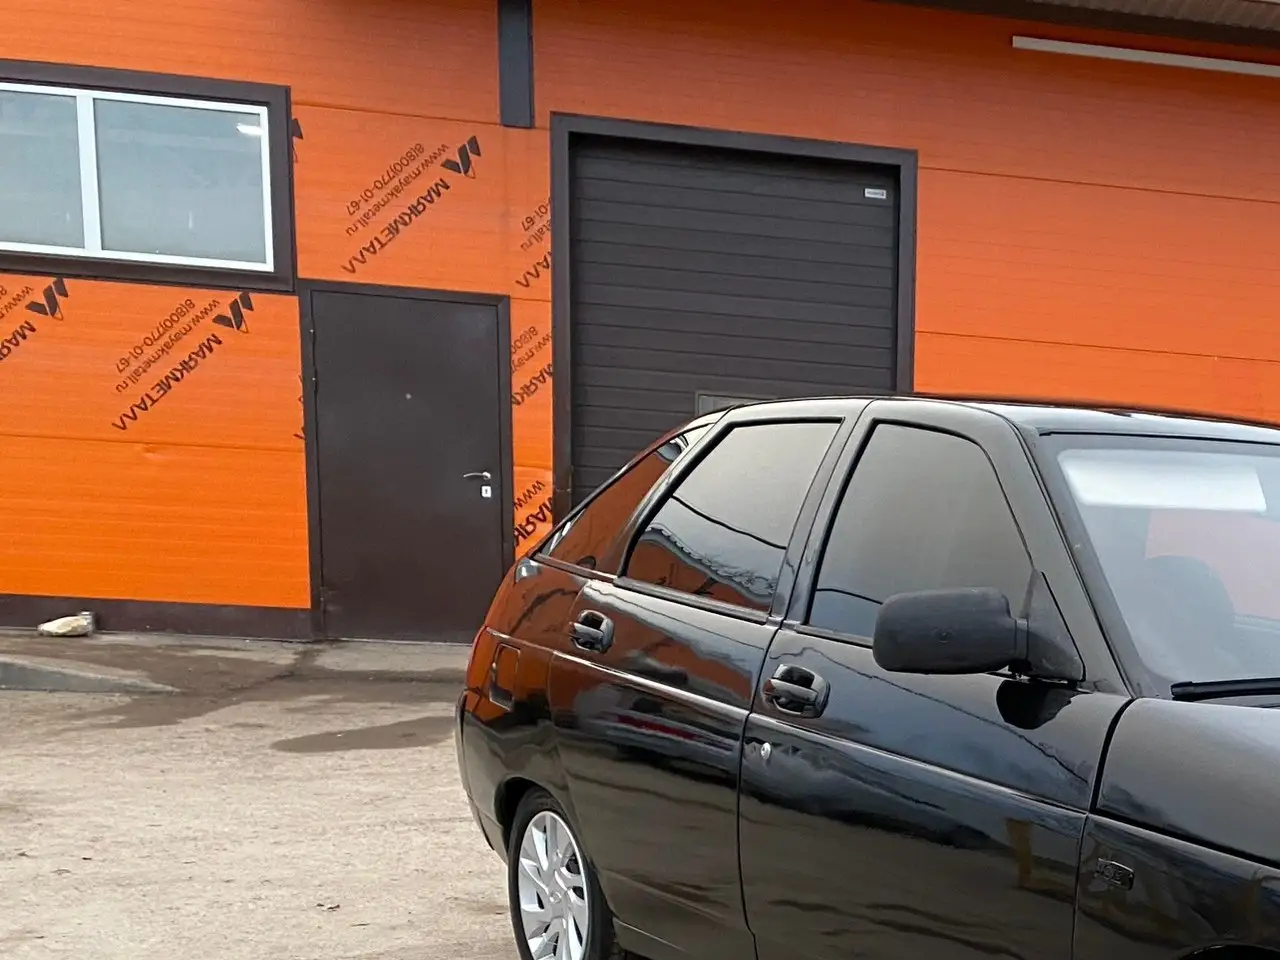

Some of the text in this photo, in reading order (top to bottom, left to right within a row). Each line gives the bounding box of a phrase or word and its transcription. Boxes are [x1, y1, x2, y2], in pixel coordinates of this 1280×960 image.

[345, 143, 449, 237] www.mayakmetall.ru
[116, 298, 195, 373] 8(800)770-01-67
[116, 299, 221, 393] www.mayakmetall.ru
